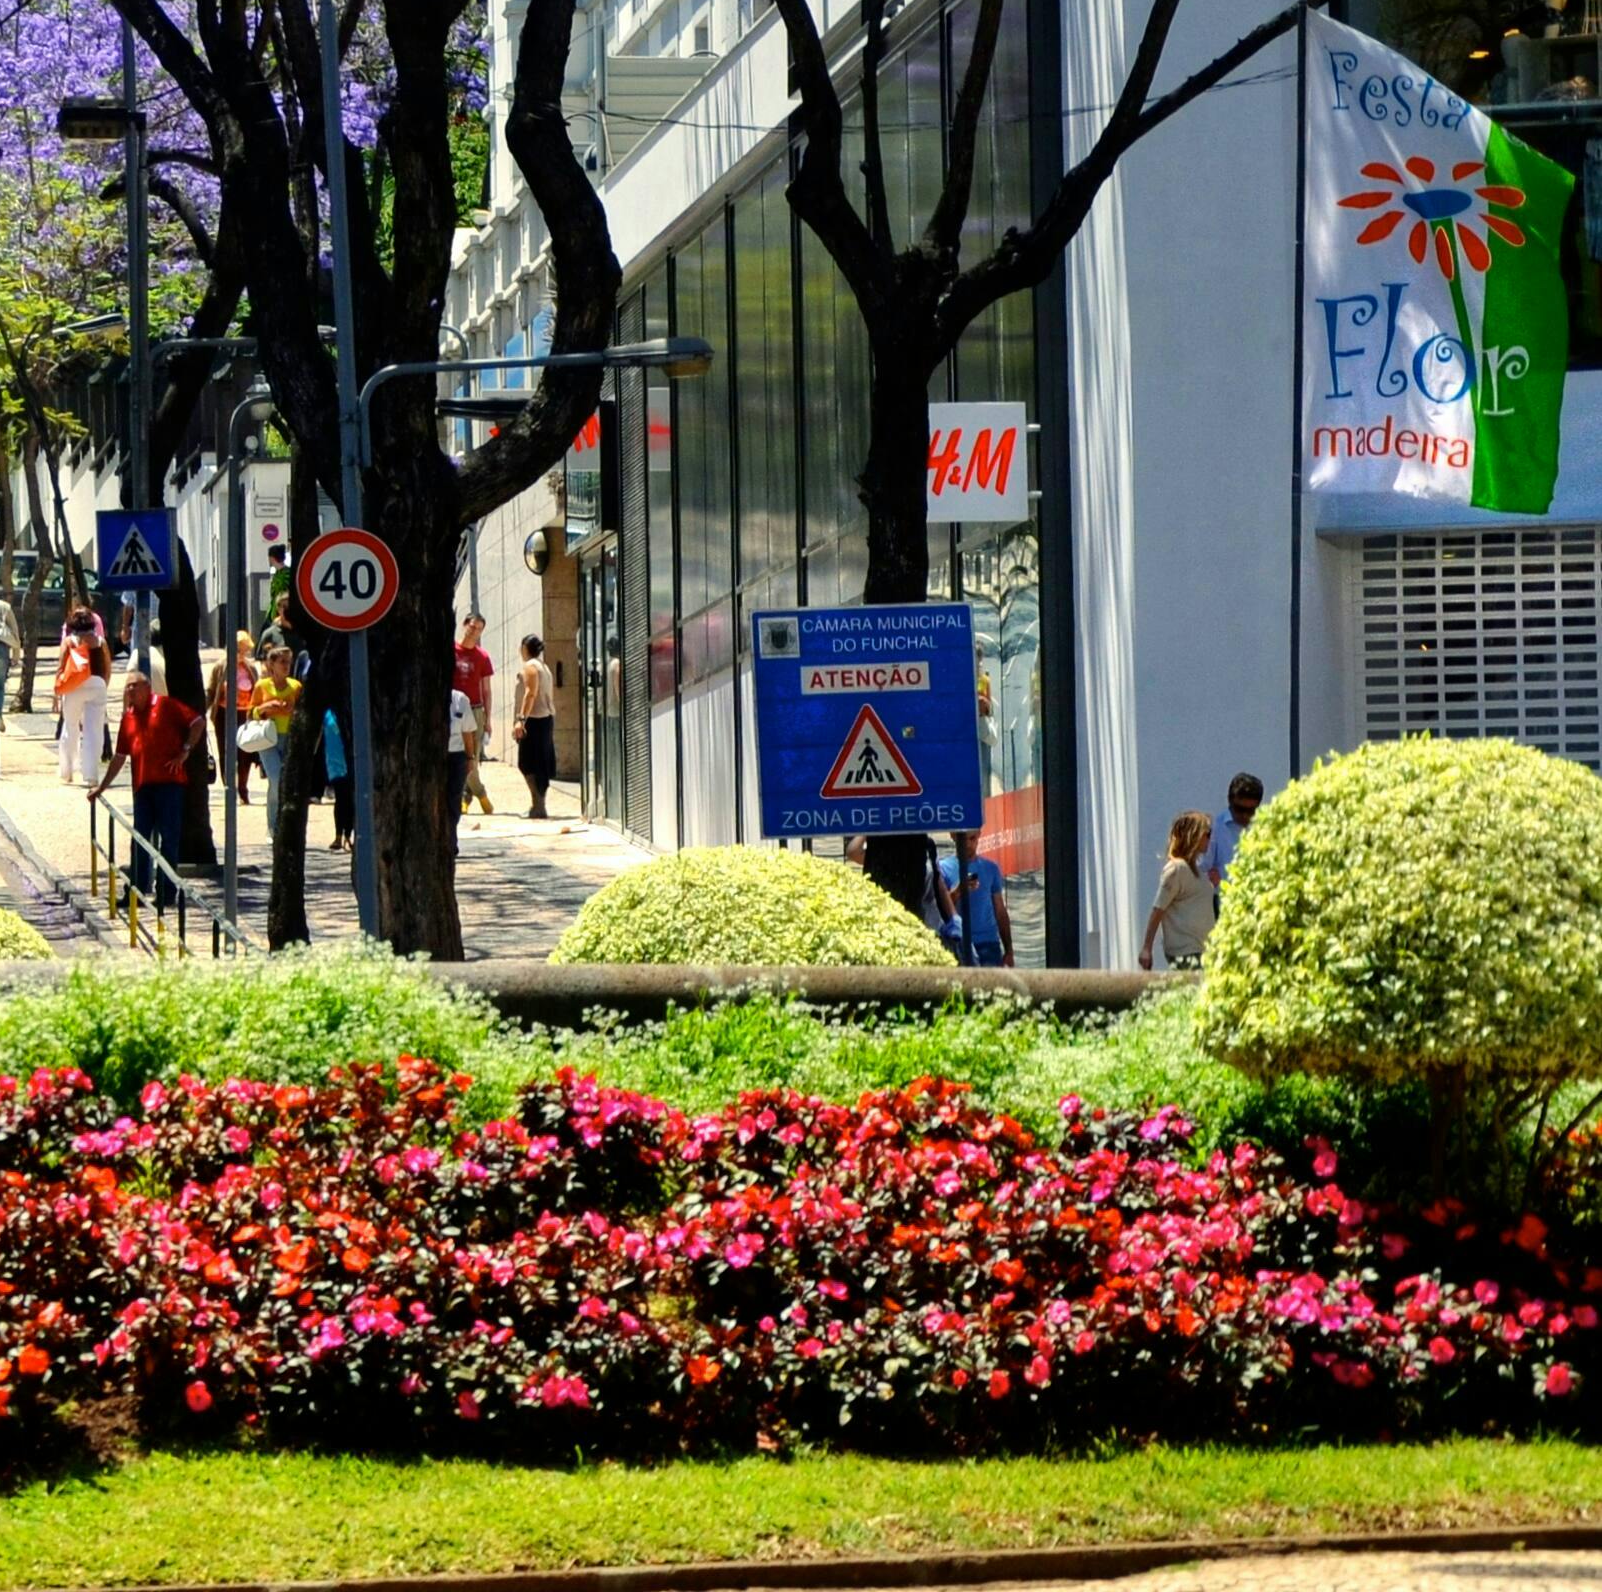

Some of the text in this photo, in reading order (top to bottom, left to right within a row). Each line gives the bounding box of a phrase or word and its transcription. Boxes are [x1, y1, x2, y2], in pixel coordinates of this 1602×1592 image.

[1325, 48, 1471, 132] Festa
[1316, 282, 1530, 416] Flor
[926, 427, 1017, 496] H&M
[1312, 415, 1470, 470] madeira
[319, 559, 378, 600] 40
[802, 614, 966, 633] CÂMARA MUNICIPAL
[833, 635, 939, 652] DO FUNCHAL
[810, 664, 922, 691] ATENÇÃO
[781, 801, 965, 828] ZONA DE PEÕES
